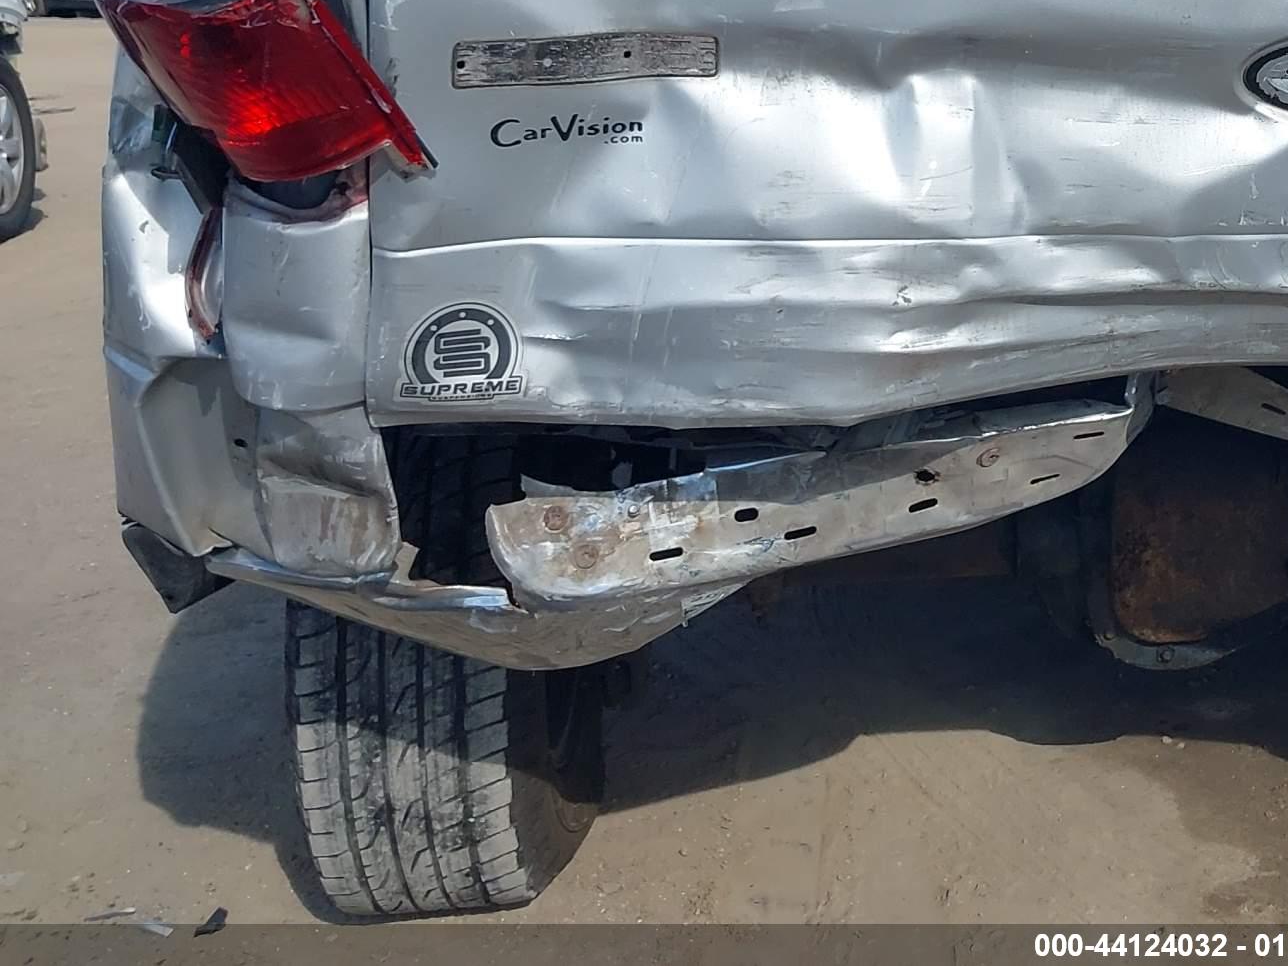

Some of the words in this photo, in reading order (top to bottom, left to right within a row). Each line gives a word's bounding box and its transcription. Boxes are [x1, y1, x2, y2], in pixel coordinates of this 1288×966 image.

[490, 114, 643, 147] CarVision
[604, 135, 643, 144] .com
[403, 379, 519, 395] SUPREME
